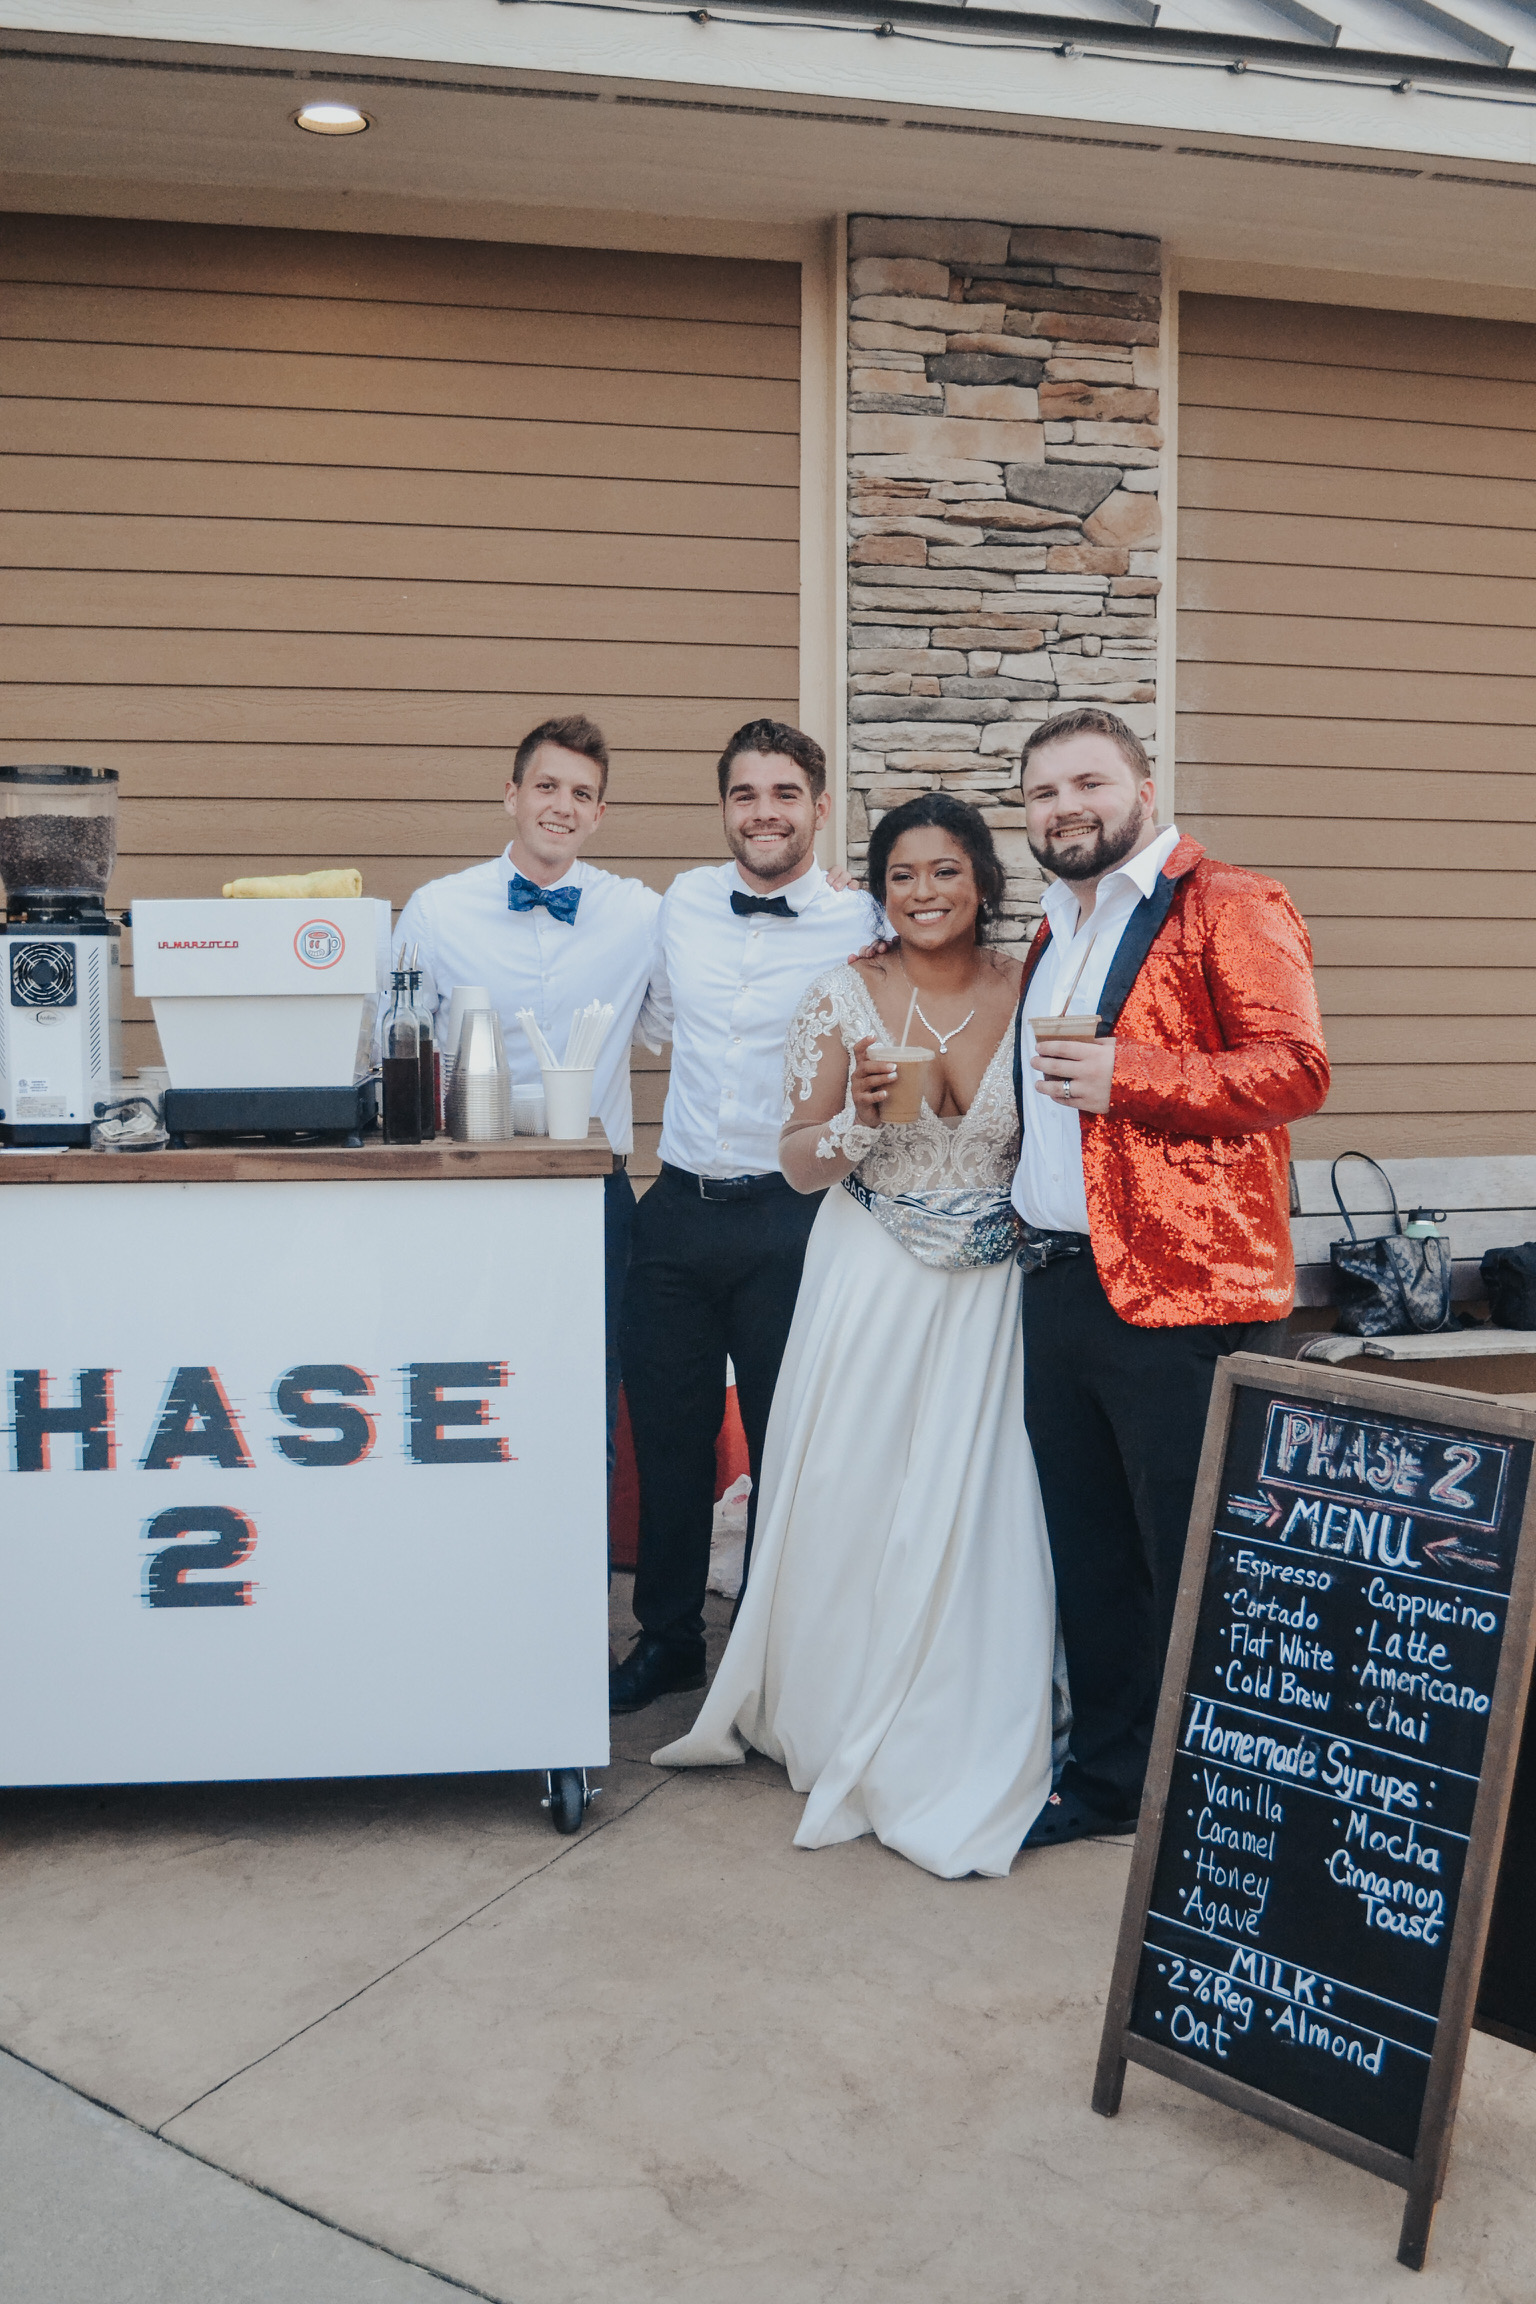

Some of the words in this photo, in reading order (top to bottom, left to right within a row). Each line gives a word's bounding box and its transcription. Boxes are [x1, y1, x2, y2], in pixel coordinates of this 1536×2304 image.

[1277, 1413, 1428, 1497] PHASE
[1429, 1445, 1481, 1509] 2
[139, 1505, 258, 1609] 2
[1279, 1497, 1422, 1568] MENU
[1236, 1550, 1332, 1591] Espresso
[1231, 1588, 1319, 1630] Cortado
[1368, 1576, 1497, 1633] Cappucino
[1231, 1623, 1273, 1658] Flat
[1279, 1632, 1334, 1672] White
[1367, 1620, 1451, 1671] Latte
[1226, 1660, 1272, 1699] Cold
[1279, 1672, 1332, 1712] Brew
[1360, 1659, 1490, 1714] Americano
[1184, 1700, 1317, 1779] Homemade
[1366, 1696, 1430, 1744] Chai
[1203, 1768, 1284, 1823] Vanilla
[1197, 1807, 1276, 1861] Caramel
[1345, 1810, 1440, 1874] Mocha
[1197, 1848, 1270, 1914] Honey
[1329, 1849, 1444, 1913] Cinnamon
[1183, 1886, 1260, 1937] Agave
[1359, 1892, 1445, 1945] Toast
[1228, 1947, 1334, 2007] MILK:
[1170, 2004, 1231, 2057] Oat
[1271, 2008, 1385, 2075] Almond
